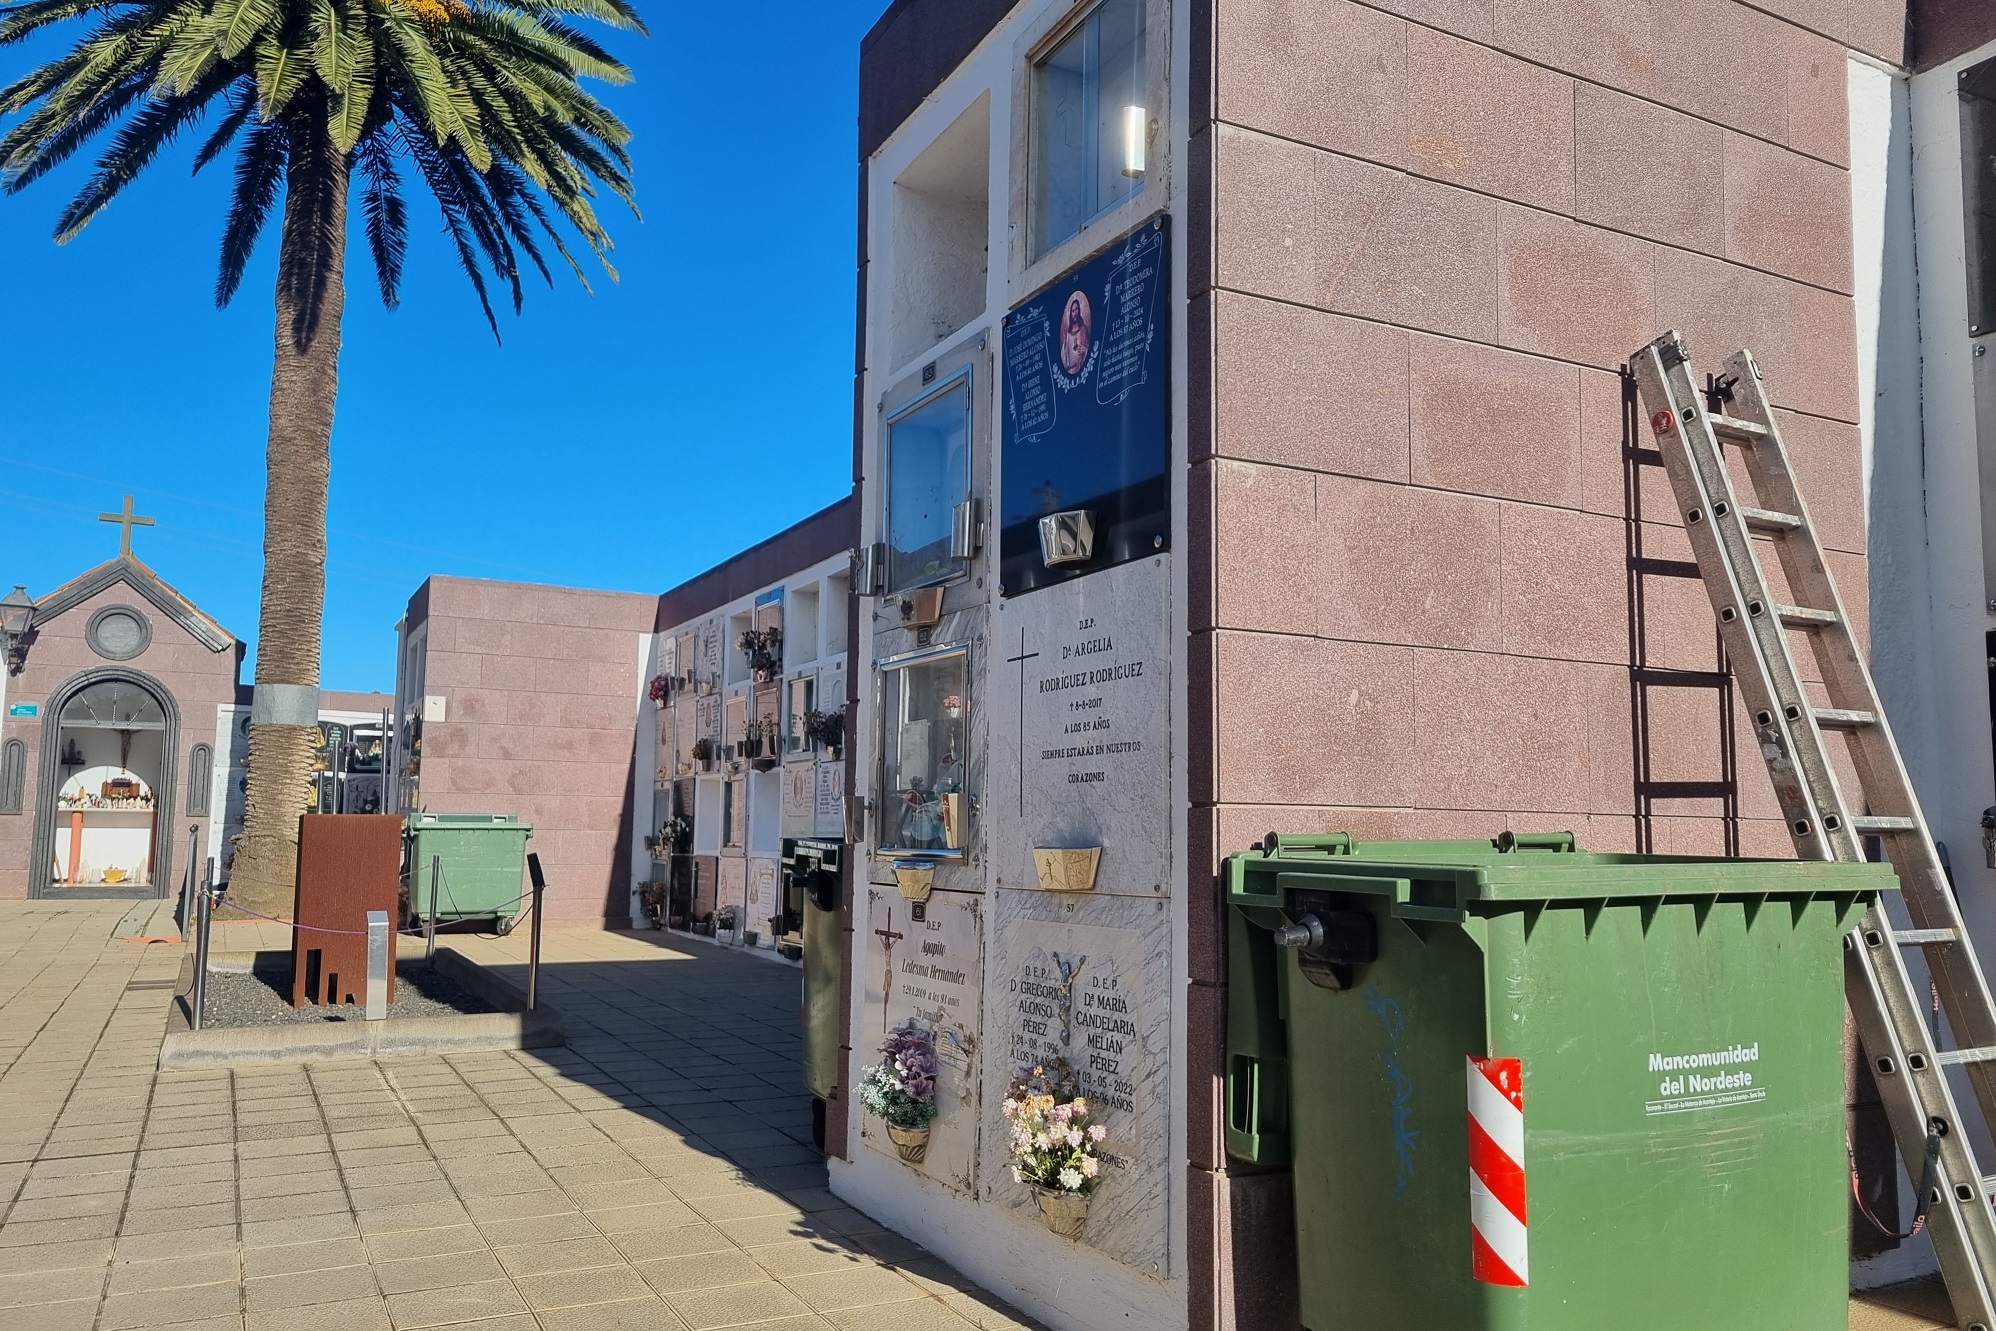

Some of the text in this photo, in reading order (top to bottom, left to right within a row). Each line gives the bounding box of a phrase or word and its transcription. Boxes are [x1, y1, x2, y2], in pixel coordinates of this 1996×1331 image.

[1123, 266, 1154, 290] TEODOMIRA
[1120, 282, 1144, 304] MARRERO
[1120, 296, 1140, 315] ALONSO
[1113, 328, 1123, 340] LOS
[1128, 317, 1143, 334] AÑOS
[1029, 340, 1045, 356] ALONSO
[924, 368, 932, 379] 63
[1028, 375, 1040, 388] IRENE
[1022, 392, 1047, 412] HERNÁNDEZ
[1025, 386, 1041, 401] ALONSO
[1079, 617, 1096, 630] D.E.P.
[920, 632, 927, 641] 62
[1074, 636, 1113, 658] ARGELIA
[1039, 660, 1143, 693] RODRÍGUEZ RODRÍGUEZ
[1064, 716, 1110, 734] A LOS 85 AÑOS
[1041, 740, 1141, 760] SIEMPRE ESTARÁS EN NUESTROS
[1068, 772, 1105, 784] CORAZONES
[1067, 904, 1074, 913] 57
[920, 938, 946, 957] Agapito
[902, 958, 966, 986] Ledesma Hernández
[1093, 976, 1100, 989] D.
[1112, 980, 1118, 991] P.
[940, 993, 948, 1004] 93
[1097, 994, 1127, 1013] MARÍA
[1018, 1000, 1052, 1018] ALONSO
[1023, 1017, 1048, 1036] PÉREZ
[1076, 1011, 1136, 1036] CANDELARIA
[1087, 1031, 1123, 1054] MELIÁN
[1010, 1048, 1054, 1068] A LOS 74 AÑO
[1090, 1052, 1118, 1074] PÉREZ
[1648, 1042, 1759, 1072] Mancomunidad
[1114, 1080, 1133, 1096] 2022
[1660, 1070, 1752, 1096] del Nordeste
[1076, 1086, 1081, 1097] A
[1111, 1096, 1133, 1113] AÑOS
[1092, 1149, 1128, 1170] RAZONES"
[1913, 1215, 1925, 1235] ailo
